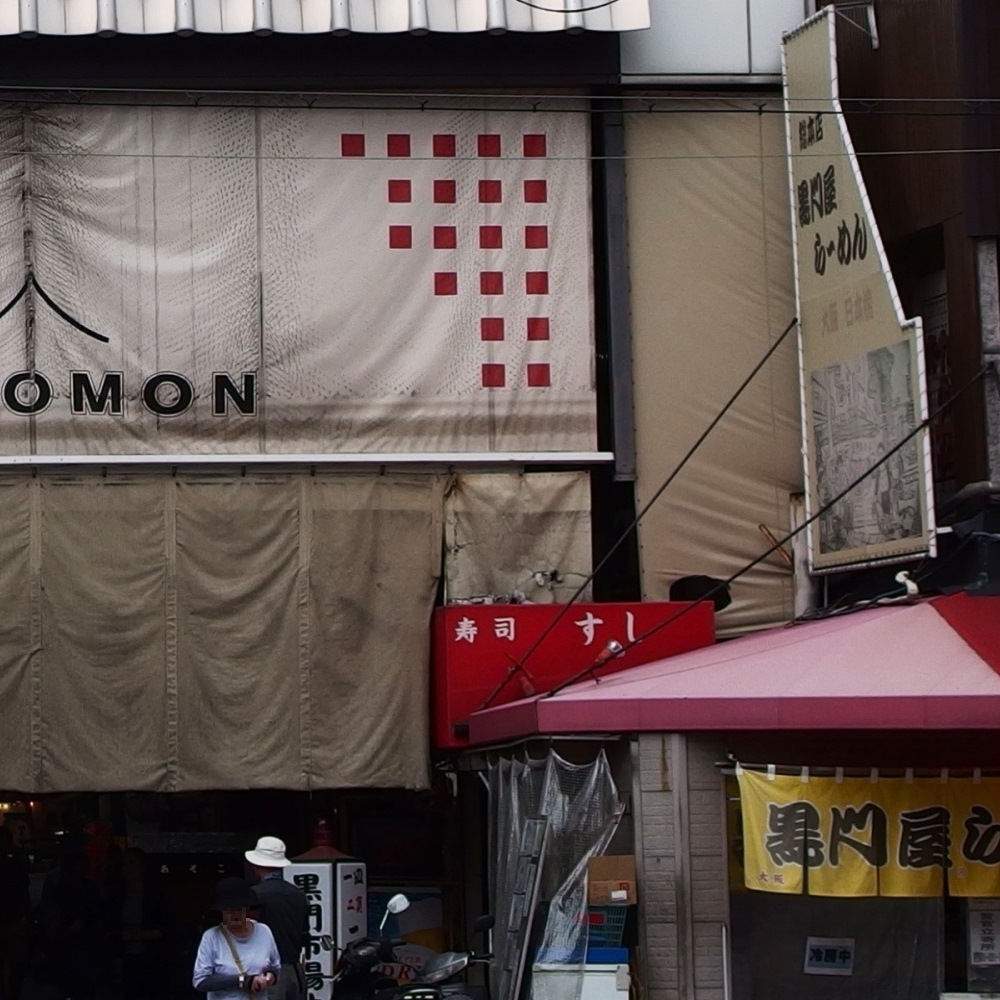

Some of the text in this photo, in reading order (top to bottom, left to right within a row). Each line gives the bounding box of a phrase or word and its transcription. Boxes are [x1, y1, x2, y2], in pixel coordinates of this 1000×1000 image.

[814, 213, 867, 276] らーめん
[454, 612, 643, 646] 寿司 すし
[293, 873, 324, 1000] 黒門市場
